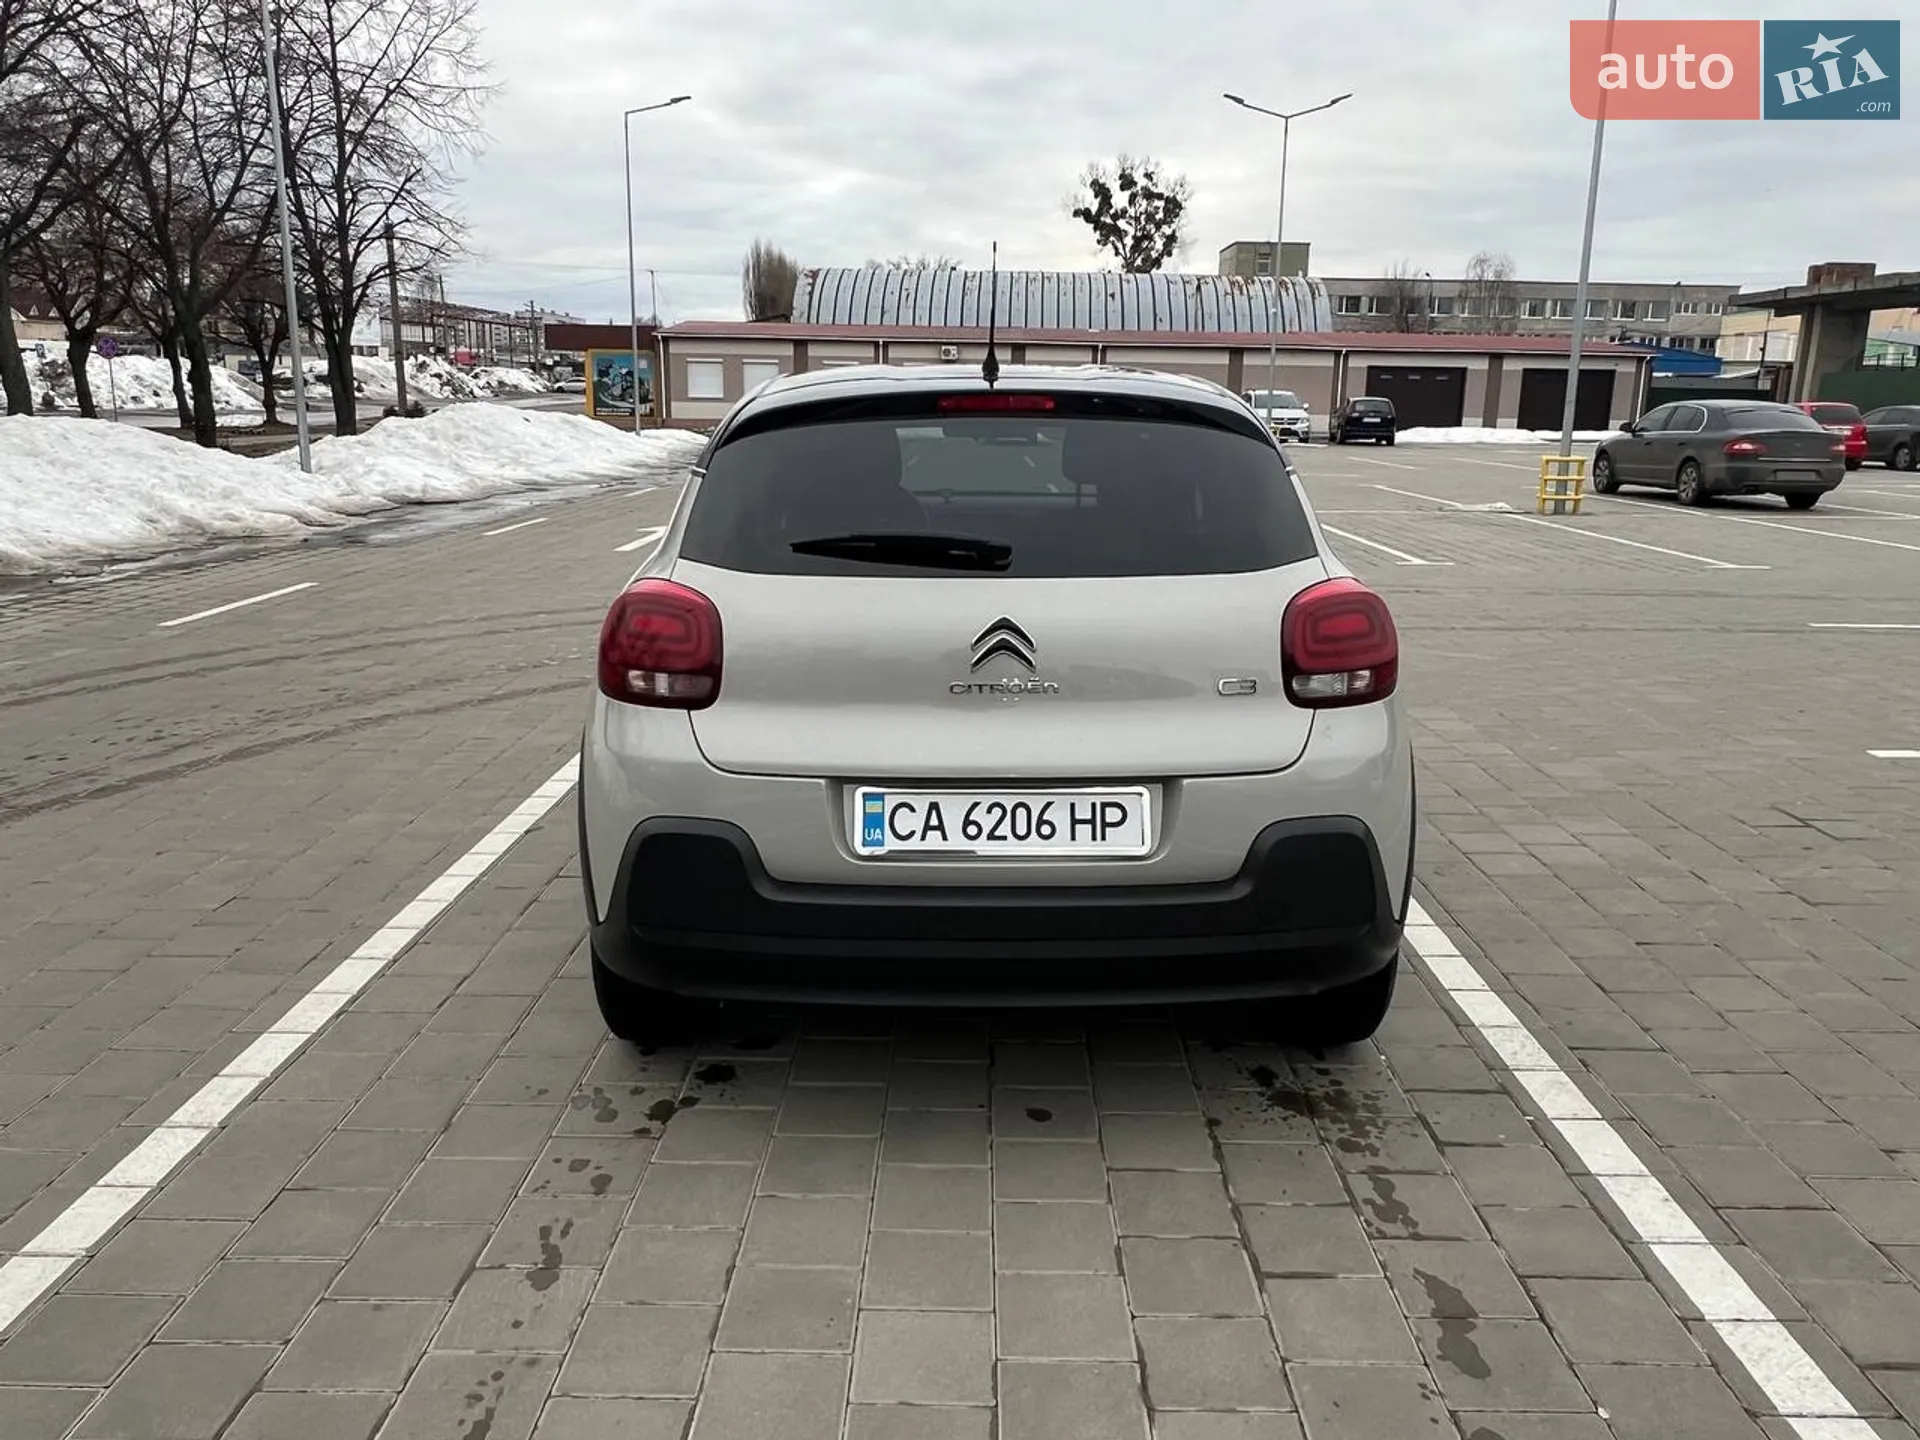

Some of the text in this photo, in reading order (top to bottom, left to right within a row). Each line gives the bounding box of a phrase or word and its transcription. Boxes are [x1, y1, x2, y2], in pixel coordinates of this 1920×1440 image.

[1216, 678, 1257, 696] C3
[888, 801, 1128, 842] CA 6206 HP
[864, 828, 882, 841] UA
